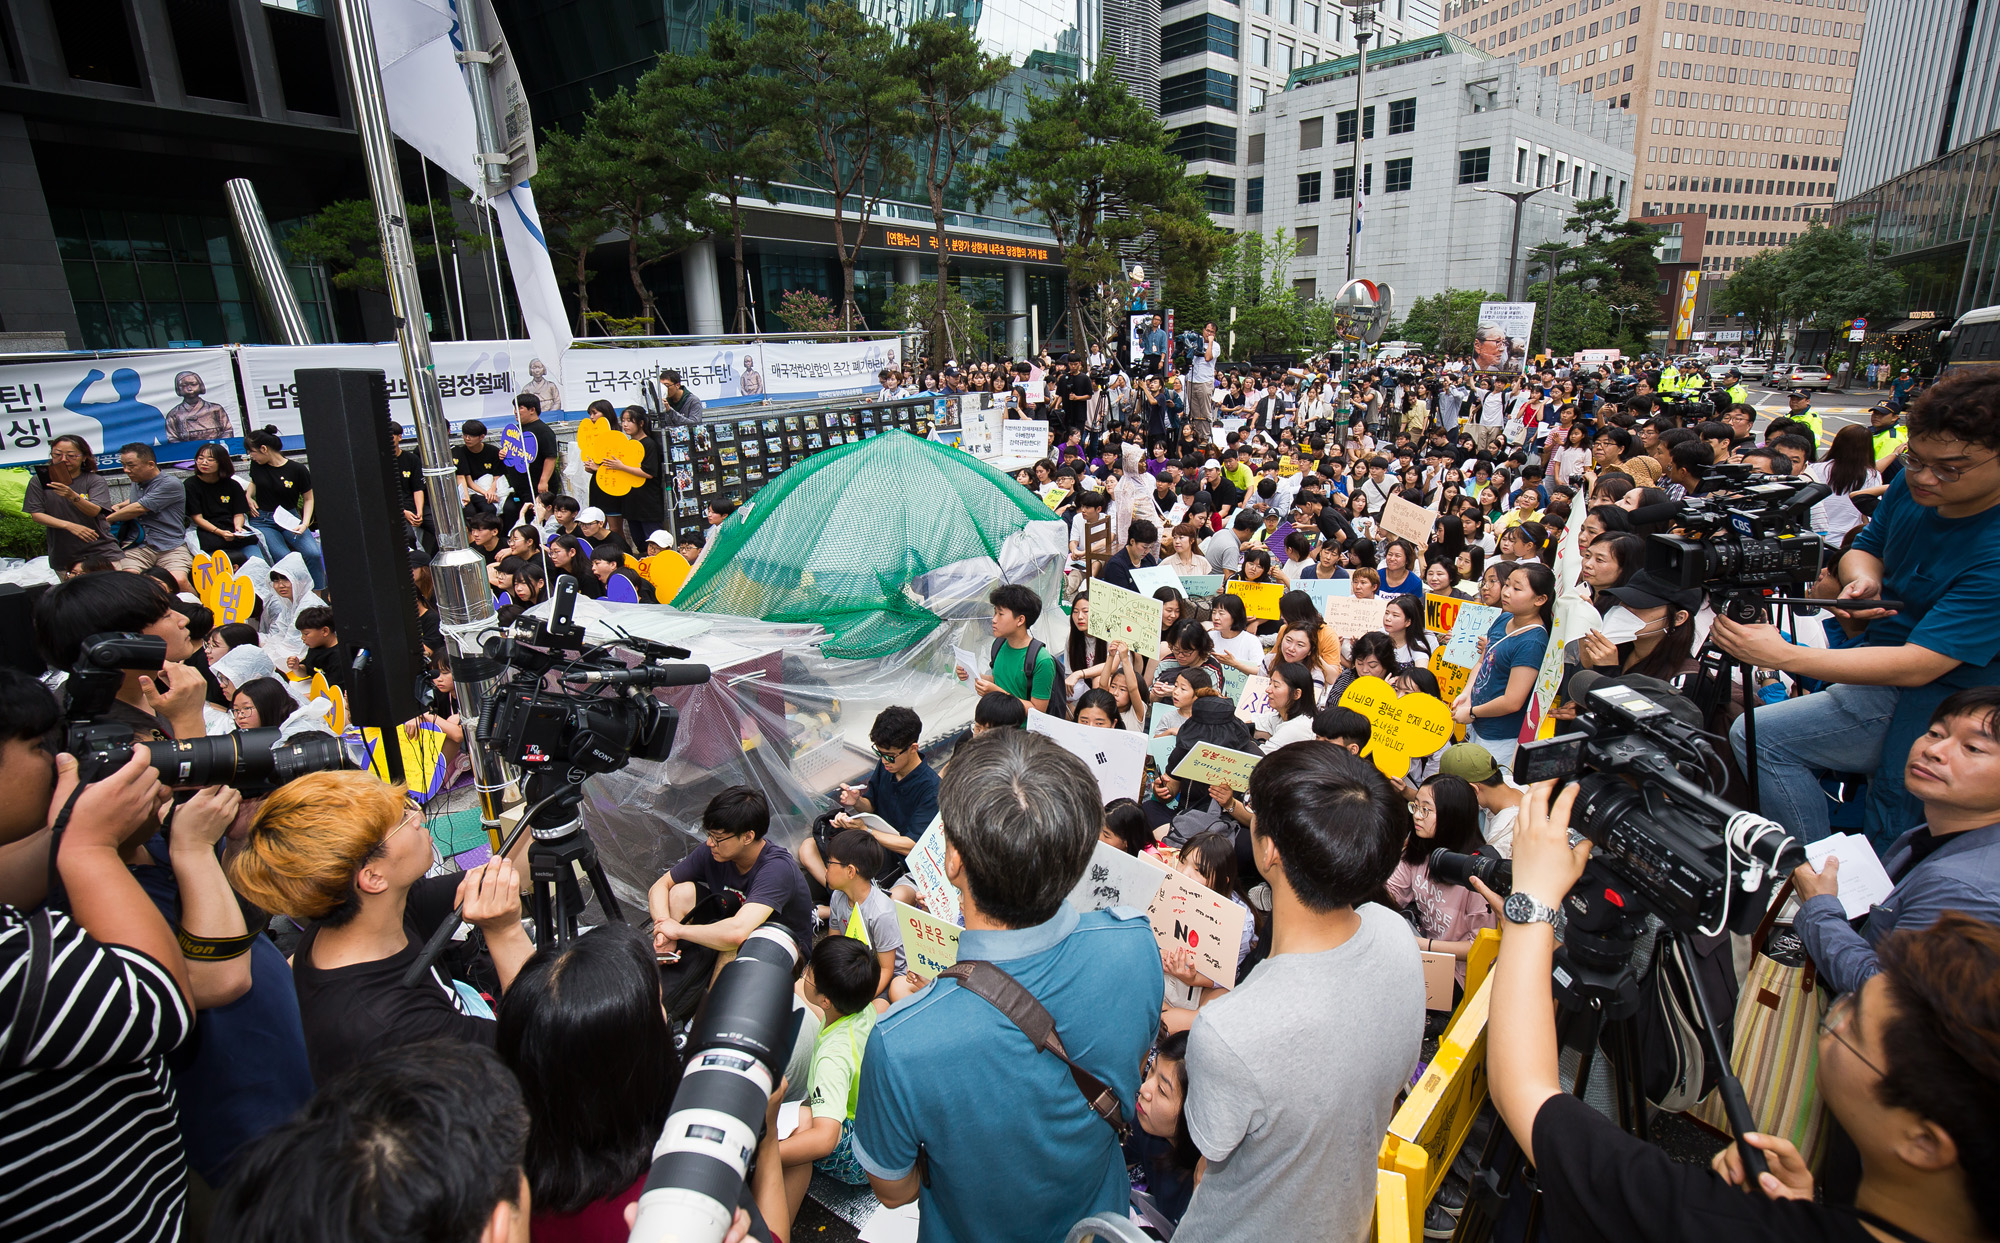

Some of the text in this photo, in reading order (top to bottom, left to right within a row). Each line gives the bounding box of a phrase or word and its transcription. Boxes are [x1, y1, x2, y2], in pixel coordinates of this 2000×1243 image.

[886, 231, 920, 248] [연합뉴스]
[929, 236, 951, 251] 국,
[951, 238, 970, 252] 분양가
[970, 241, 988, 254] 상한제
[1038, 249, 1048, 260] 발표
[771, 362, 833, 379] 매국적한일합의
[833, 362, 851, 376] 즉각
[0, 383, 47, 414] 탄!
[1732, 518, 1751, 534] CBS
[1347, 690, 1445, 737] 나비의 광복은 언제 오나요
[1371, 718, 1400, 737] 소녀상은
[1372, 731, 1405, 752] 역사입니다
[592, 748, 615, 764] SONY
[1680, 865, 1701, 882] SONY
[909, 917, 946, 947] 일본은
[177, 934, 216, 955] Nikon
